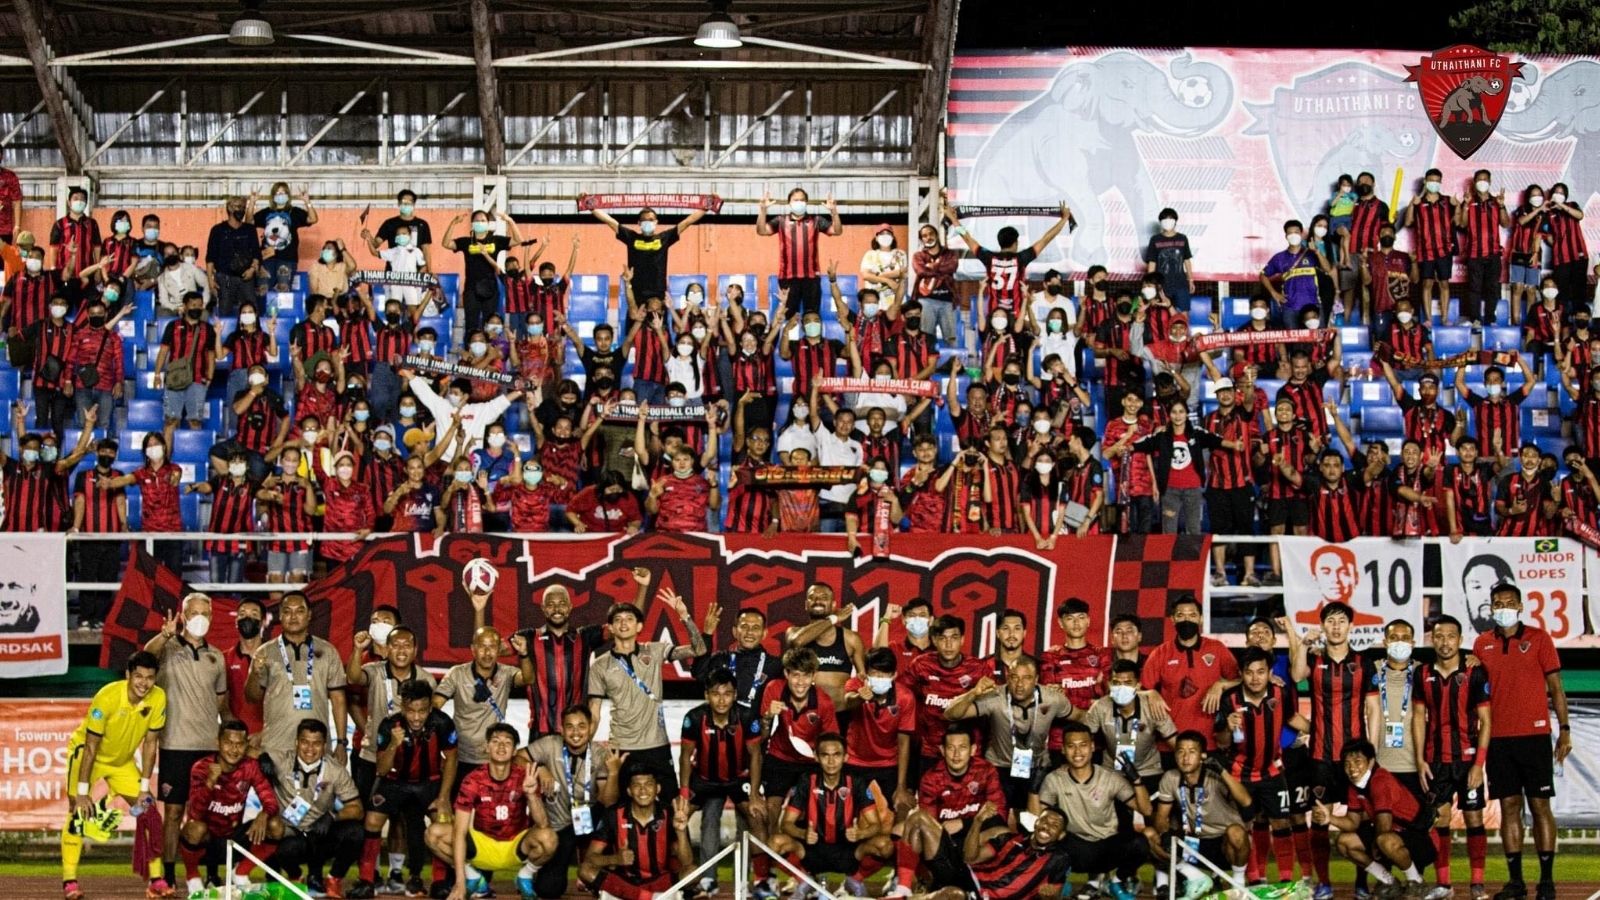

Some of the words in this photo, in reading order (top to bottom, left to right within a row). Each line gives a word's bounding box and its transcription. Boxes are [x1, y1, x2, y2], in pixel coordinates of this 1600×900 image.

[1294, 94, 1389, 113] UTHAITHANI
[1397, 94, 1416, 111] FC
[602, 195, 622, 203] UTHAI
[624, 195, 645, 203] THANI
[646, 195, 680, 203] FOOTBALL
[681, 195, 700, 203] CLUB
[364, 271, 385, 280] THANI
[386, 271, 421, 282] FOOTBALL
[991, 266, 1018, 290] 37
[1202, 333, 1226, 344] UTHAI
[1227, 331, 1250, 342] THANI
[1251, 330, 1288, 341] FOOTBALL
[1290, 329, 1310, 339] CLUB
[406, 355, 429, 366] UTHAI
[431, 359, 453, 371] THANI
[454, 364, 491, 378] FOOTBALL
[845, 377, 869, 387] THANI
[870, 378, 908, 388] FOOTBALL
[911, 380, 932, 391] CLUB
[621, 404, 640, 414] THAN
[685, 406, 705, 416] CLUB
[1519, 552, 1575, 564] JUNIOR
[1519, 568, 1566, 579] LOPES
[1364, 558, 1412, 607] 10
[1527, 590, 1569, 639] 33
[1277, 790, 1290, 808] 71
[495, 805, 508, 820] 18
